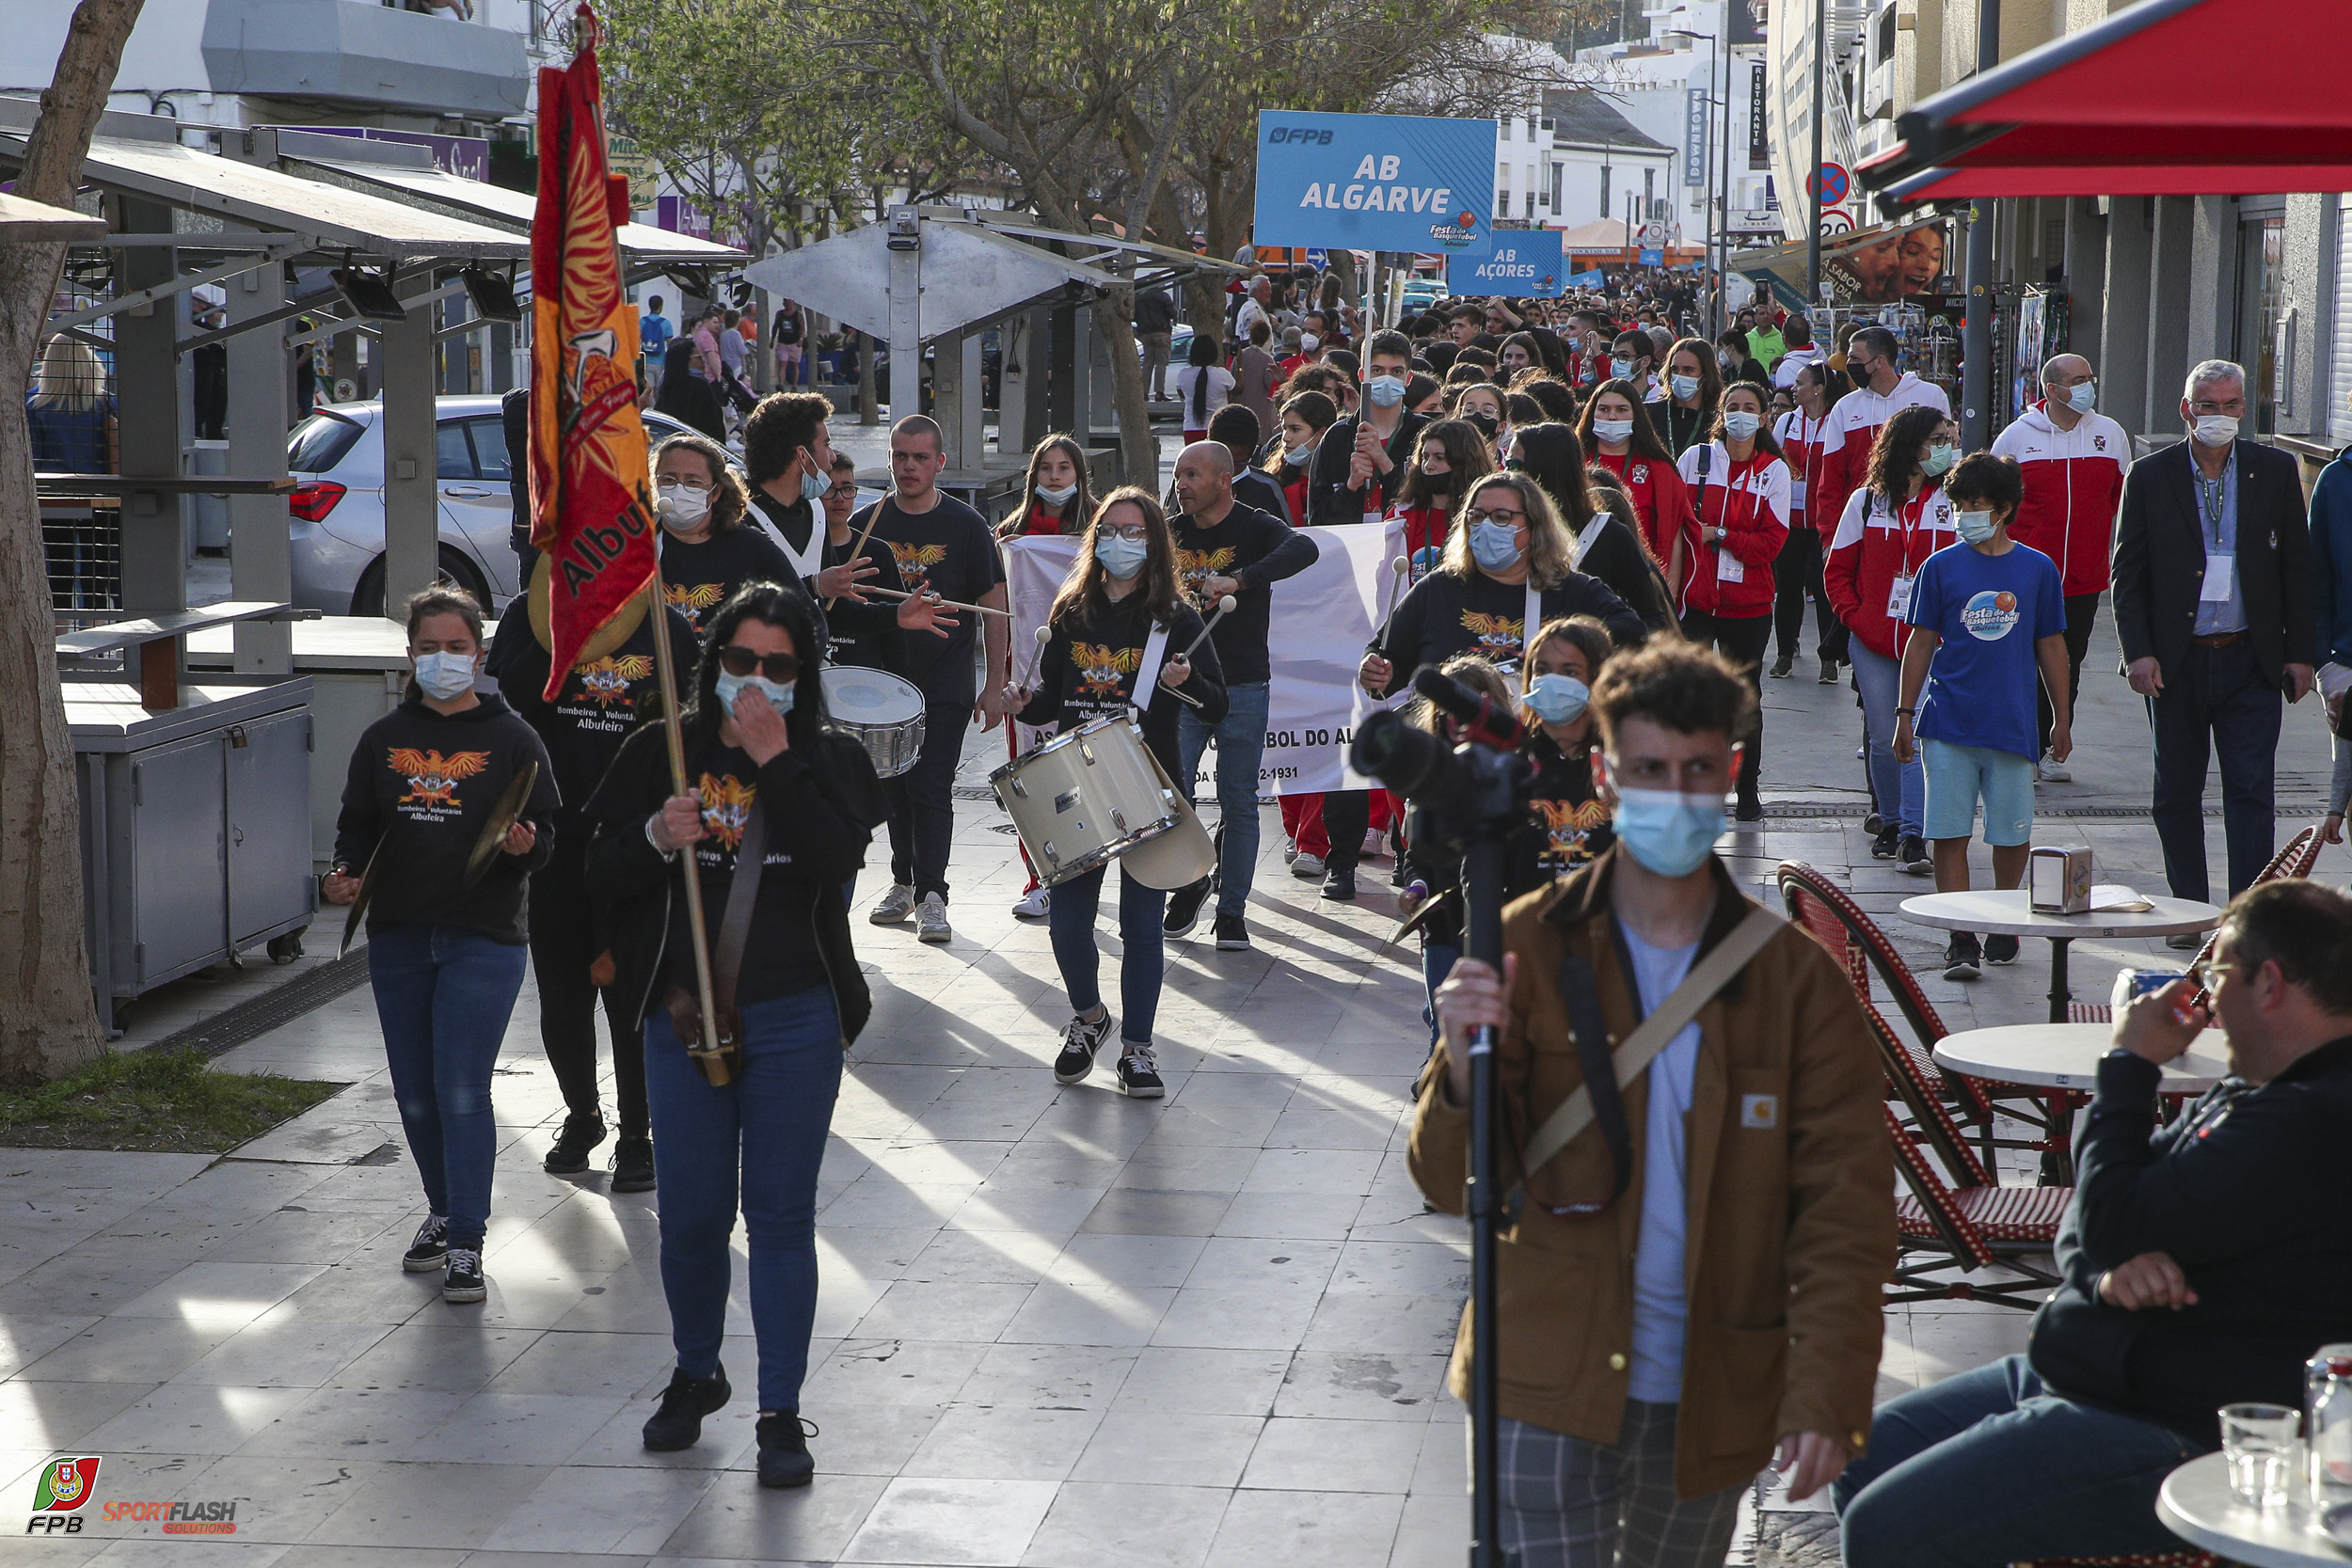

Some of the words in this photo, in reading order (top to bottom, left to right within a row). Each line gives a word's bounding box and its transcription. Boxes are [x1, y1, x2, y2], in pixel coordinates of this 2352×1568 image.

[1753, 67, 1762, 146] RISTORANTE
[1285, 129, 1334, 145] FPB
[1690, 90, 1702, 177] DOWNTOWN
[1353, 153, 1401, 182] AB
[1299, 182, 1452, 214] ALGARVE
[1430, 225, 1456, 234] Festa
[1433, 232, 1477, 241] Basquetebol
[1820, 223, 1849, 235] 20
[1494, 248, 1517, 262] AB
[1475, 263, 1535, 281] AÇORES
[1829, 264, 1862, 292] SABOR
[1836, 284, 1852, 300] DIA
[562, 479, 653, 599] Albuf
[1962, 607, 1994, 621] Festa
[1994, 609, 2005, 617] do
[1966, 613, 2018, 626] Basquetebol
[1064, 699, 1094, 708] Bombeiros
[557, 705, 597, 718] Bombeiros
[605, 710, 636, 722] Voluntá
[577, 718, 624, 733] Albufeira
[1265, 731, 1300, 749] BOL
[1305, 729, 1328, 747] DO
[1259, 767, 1298, 780] 2-1931
[410, 813, 444, 822] Albufeira
[696, 849, 722, 862] eiros
